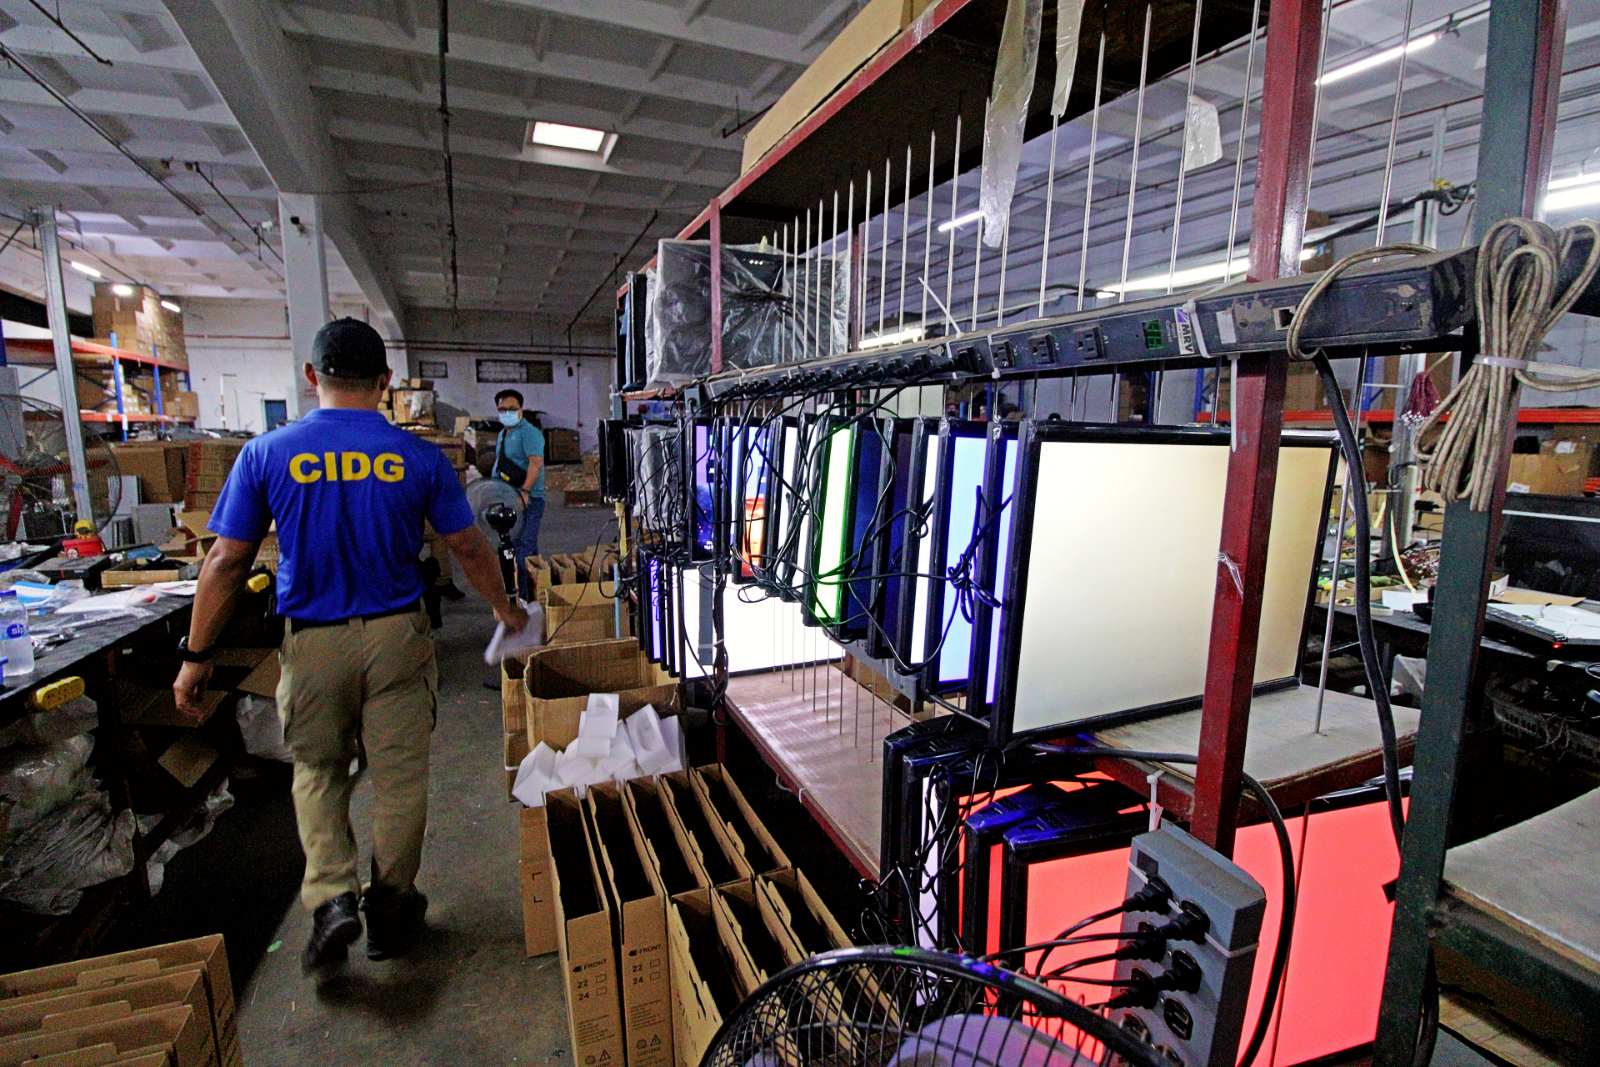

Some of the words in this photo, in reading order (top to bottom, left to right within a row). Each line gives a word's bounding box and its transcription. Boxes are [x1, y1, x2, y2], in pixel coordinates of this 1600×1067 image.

[1182, 323, 1193, 352] MRV
[289, 451, 405, 484] CIDG
[639, 944, 662, 955] FRONT
[583, 959, 607, 970] FRONT
[631, 964, 643, 973] 22
[577, 979, 589, 989] 22
[632, 976, 644, 985] 24
[578, 991, 590, 1001] 24
